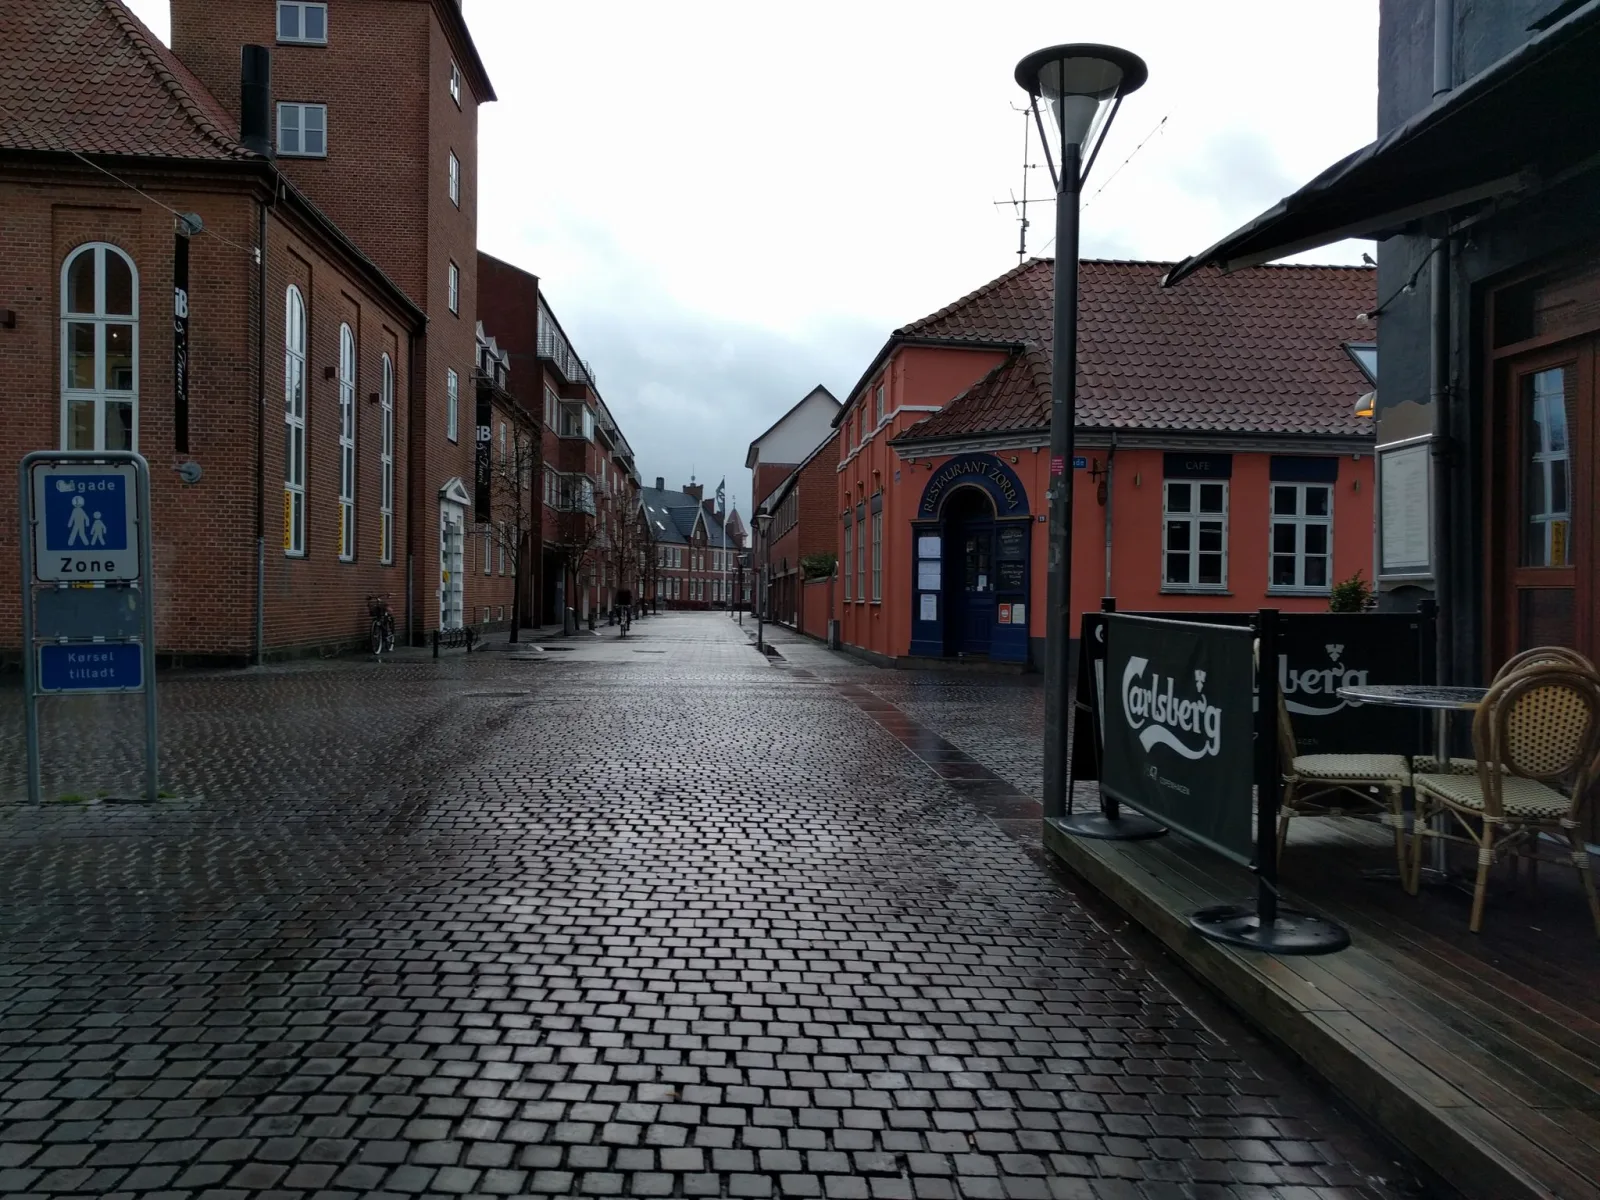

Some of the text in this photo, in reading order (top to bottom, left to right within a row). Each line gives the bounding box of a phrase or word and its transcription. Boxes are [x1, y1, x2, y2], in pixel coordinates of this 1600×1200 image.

[1186, 461, 1211, 471] CAFE
[924, 461, 1019, 512] RESTAURANT ZORBA
[60, 557, 115, 572] Zone
[68, 652, 114, 662] Kørsel
[69, 668, 115, 679] tilladt
[1122, 656, 1222, 756] Carlsberg
